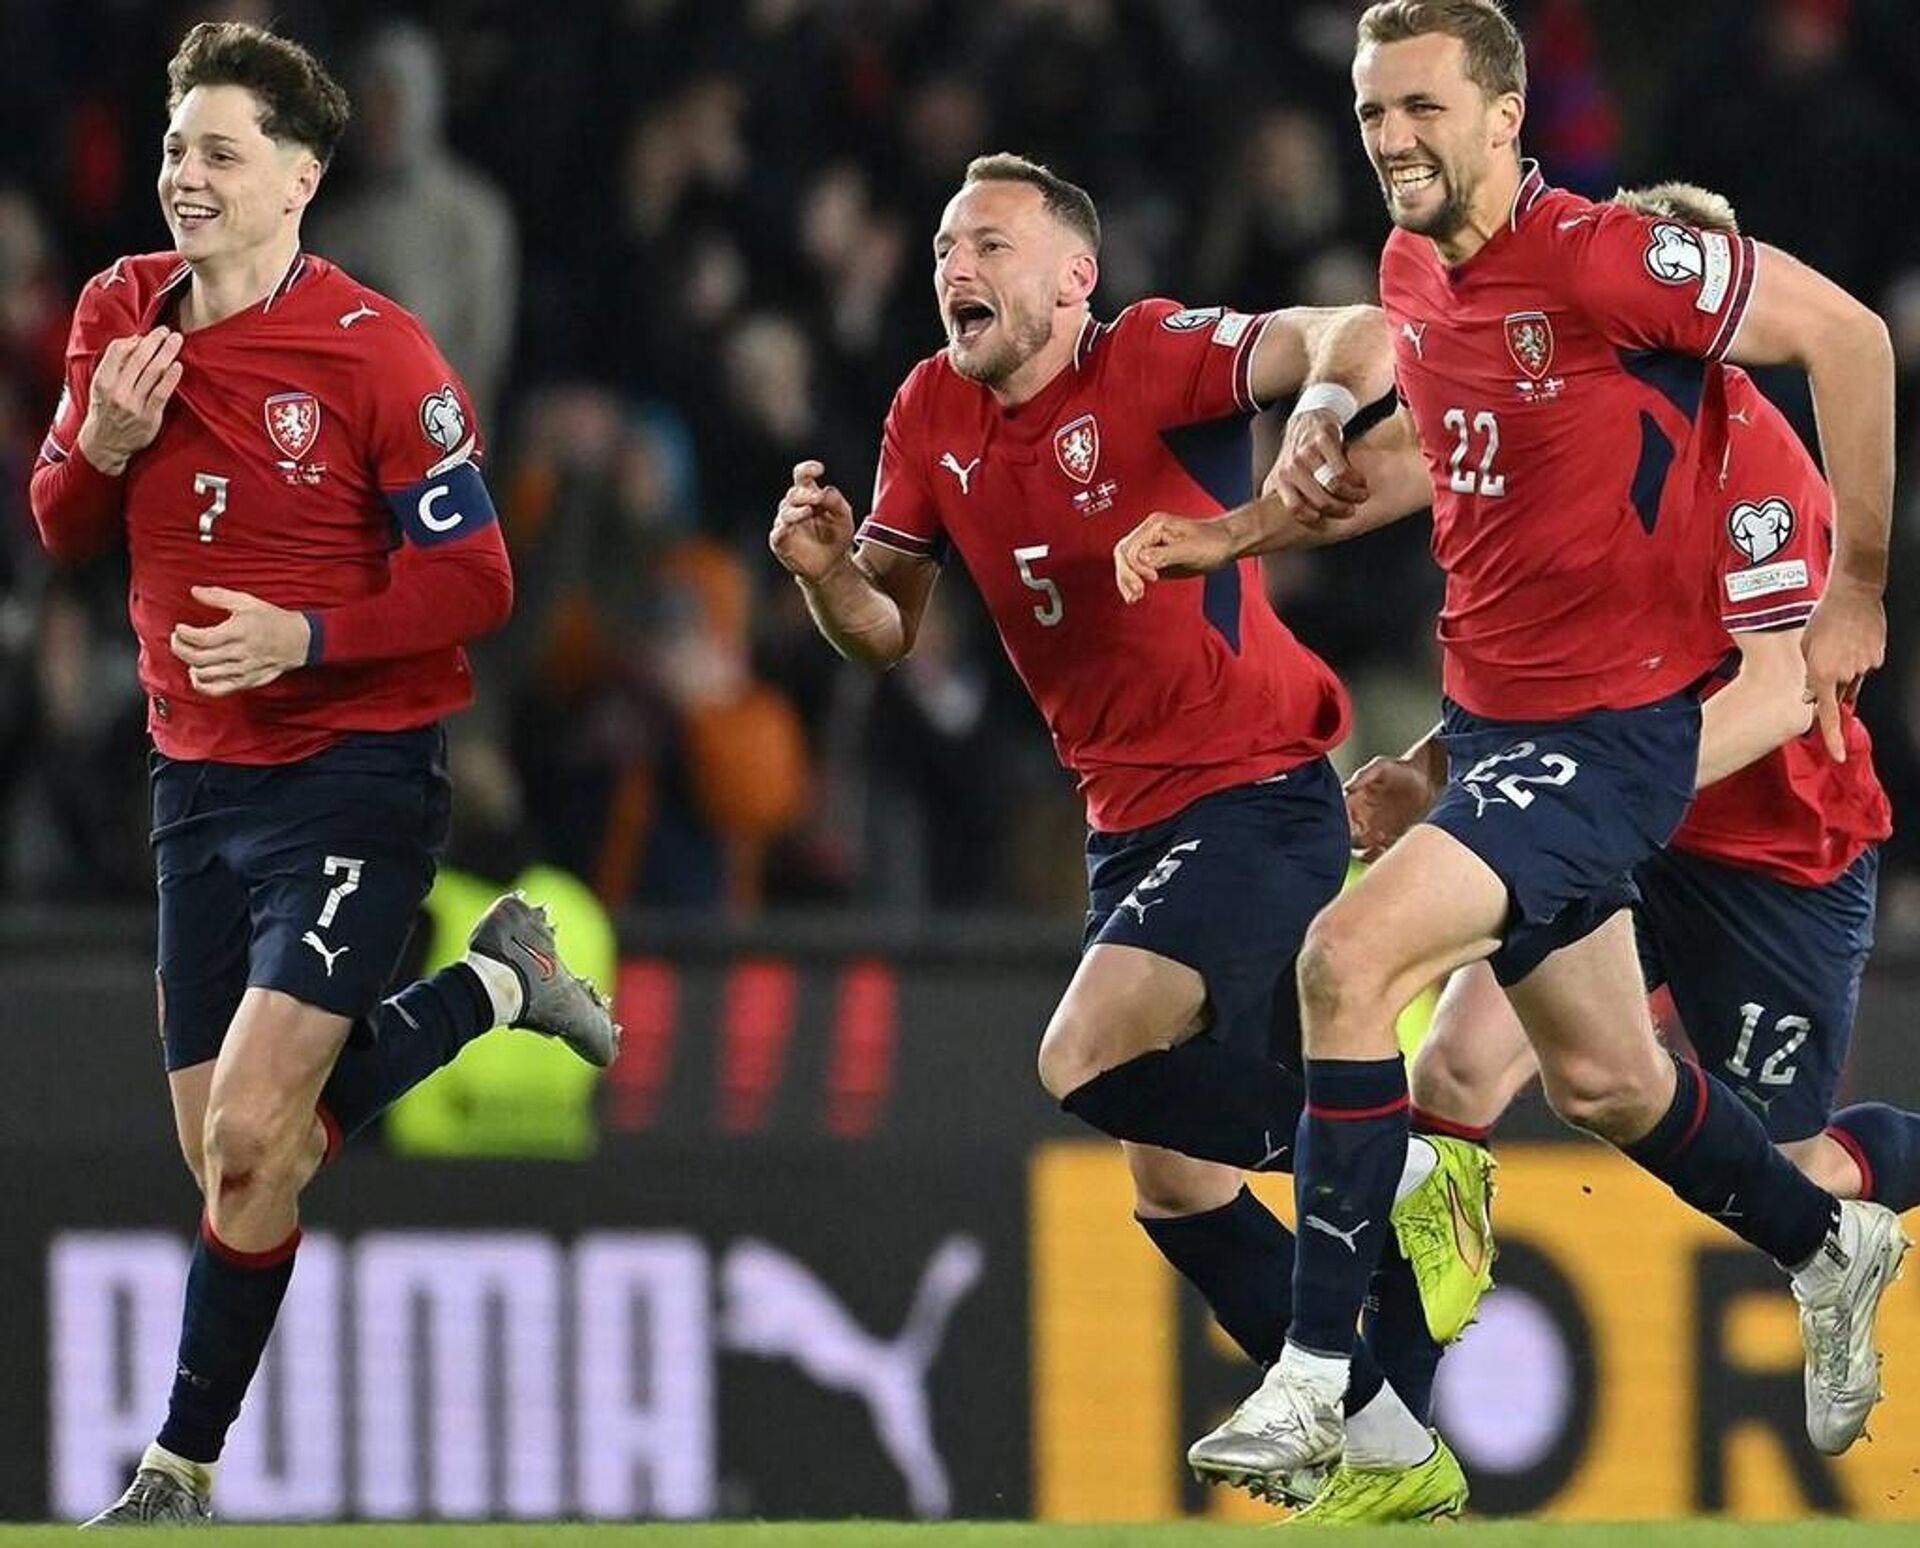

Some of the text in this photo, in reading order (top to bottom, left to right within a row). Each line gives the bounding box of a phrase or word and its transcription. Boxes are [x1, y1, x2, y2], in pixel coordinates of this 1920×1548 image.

[1443, 408, 1505, 497] 22
[194, 473, 228, 541] 7
[418, 486, 462, 532] C
[1014, 545, 1063, 627] 5
[1462, 741, 1579, 810] 22
[318, 856, 364, 928] 7
[1725, 1002, 1813, 1085] 12
[48, 1232, 715, 1519] PUMA
